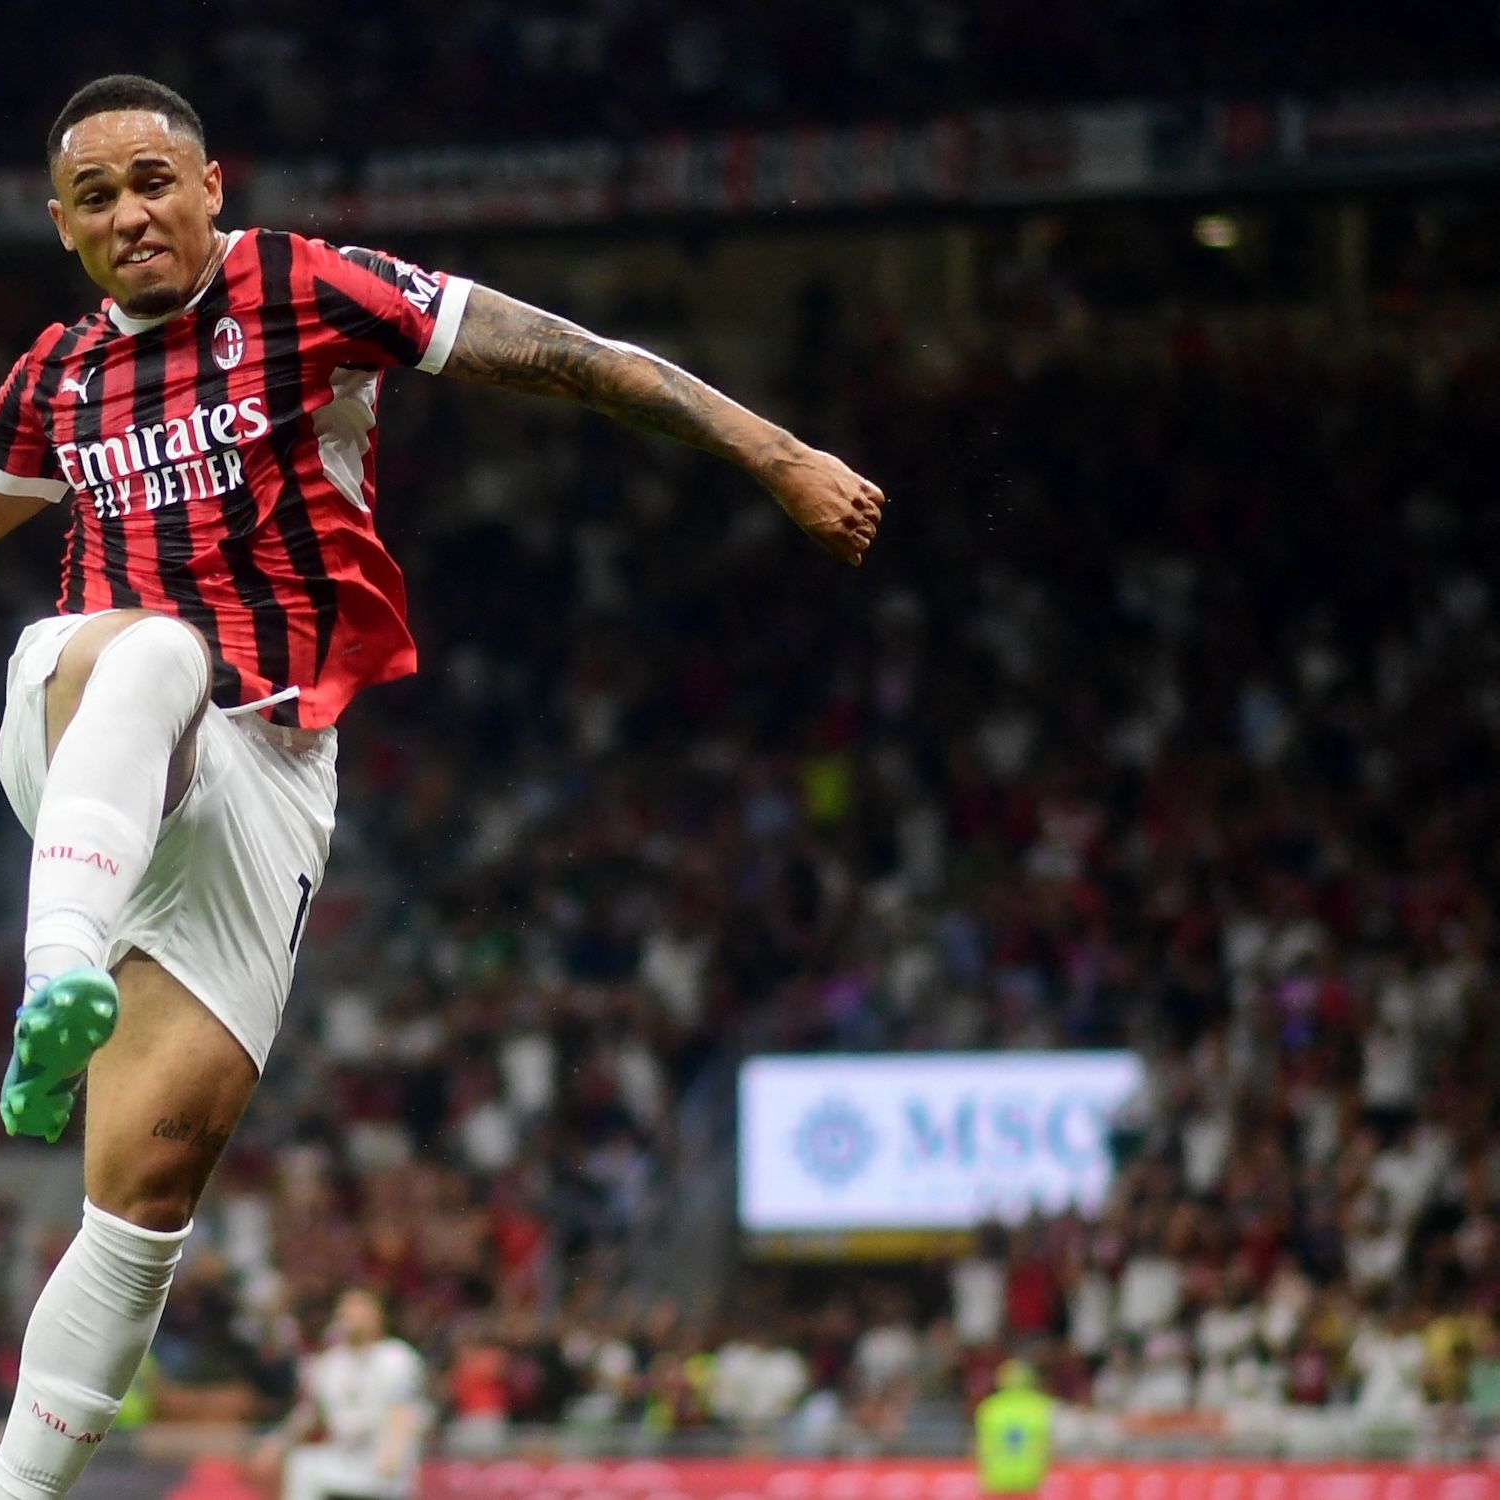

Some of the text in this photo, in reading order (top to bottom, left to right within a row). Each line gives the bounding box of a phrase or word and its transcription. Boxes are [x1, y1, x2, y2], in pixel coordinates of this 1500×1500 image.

[56, 397, 269, 491] Emirates
[93, 448, 245, 519] FLY BETTER
[37, 845, 119, 876] MILAN
[31, 1402, 105, 1443] MILAN
